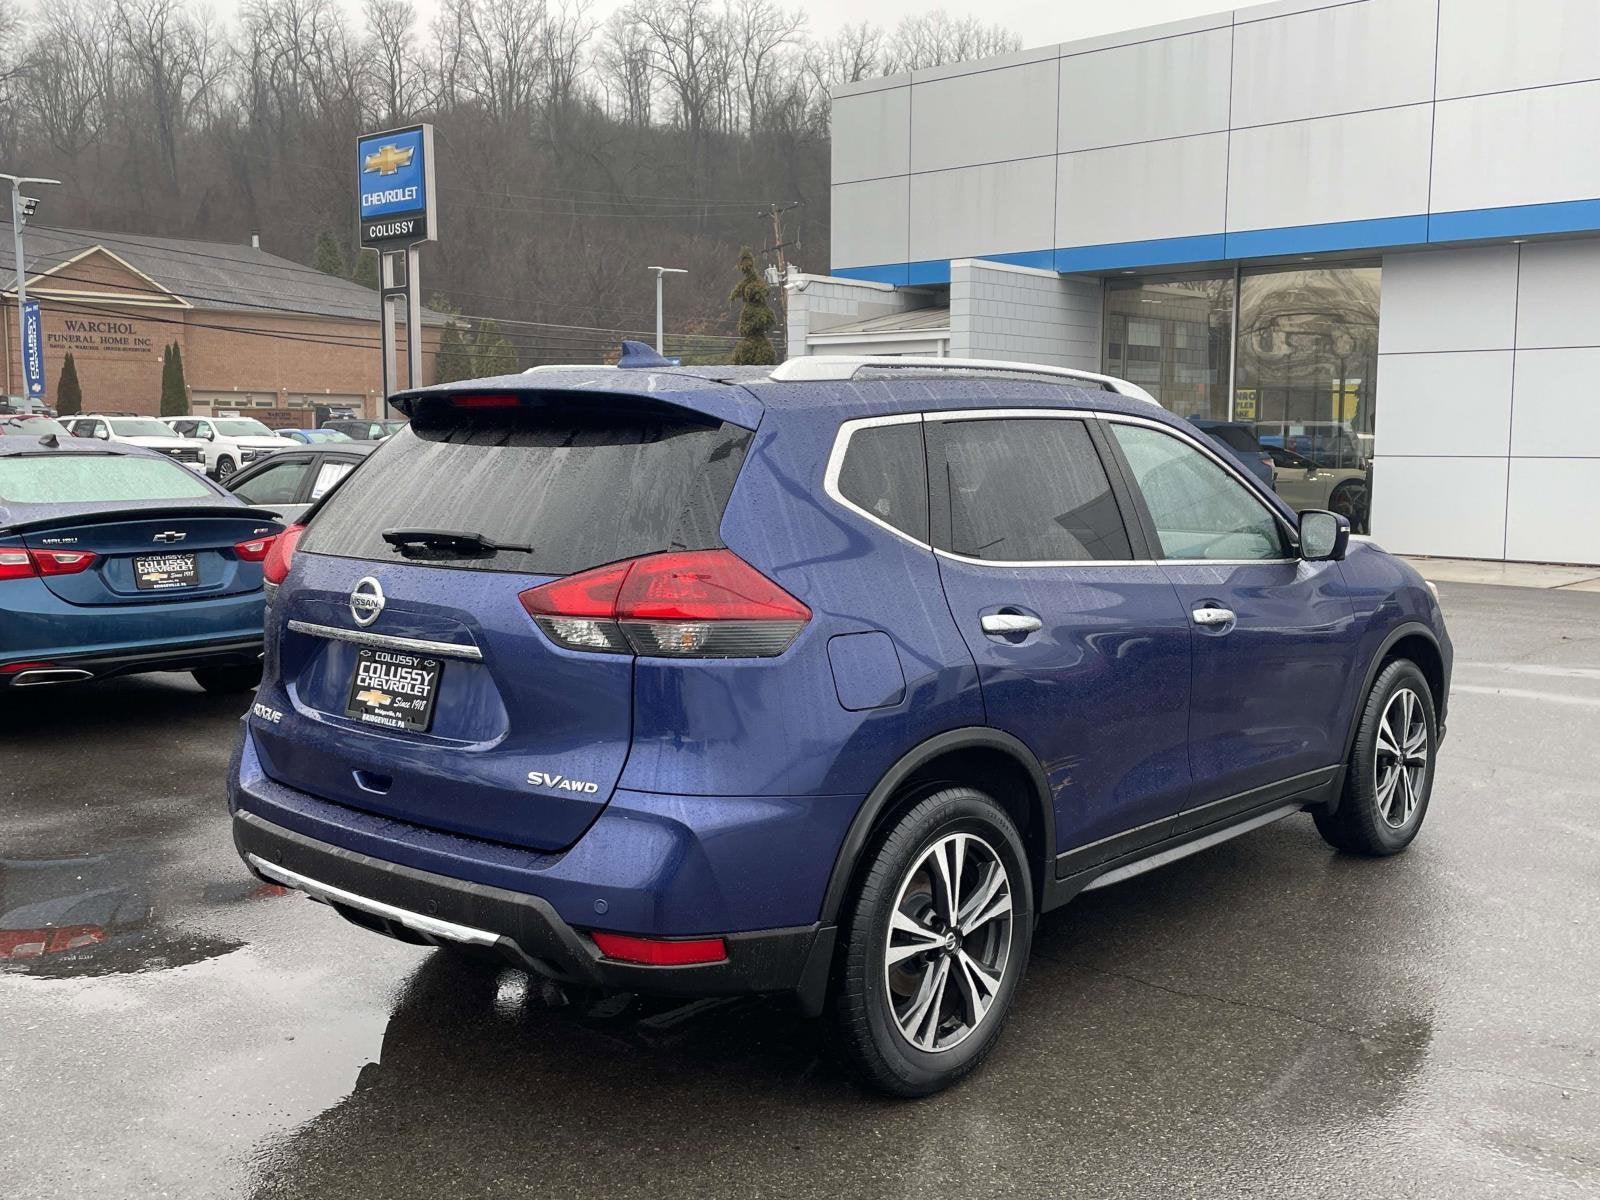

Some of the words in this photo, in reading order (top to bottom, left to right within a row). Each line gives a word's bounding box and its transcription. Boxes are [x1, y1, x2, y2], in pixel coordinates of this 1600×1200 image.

[362, 186, 418, 206] CHEVROLET
[369, 221, 414, 237] COLUSSY
[65, 320, 136, 335] WARCHOL
[47, 333, 95, 344] FUNERAL
[100, 336, 129, 345] HOME
[42, 537, 78, 545] MALIBU
[137, 558, 194, 569] COLUSSY
[351, 596, 378, 608] NISSAN
[375, 651, 421, 667] COLUSSY
[359, 661, 435, 686] COLUSSY
[356, 675, 431, 697] CHEVROLET
[393, 696, 411, 708] Since
[411, 699, 427, 711] 1918
[397, 719, 405, 728] PA
[527, 771, 563, 788] SV
[558, 779, 599, 793] AWD
